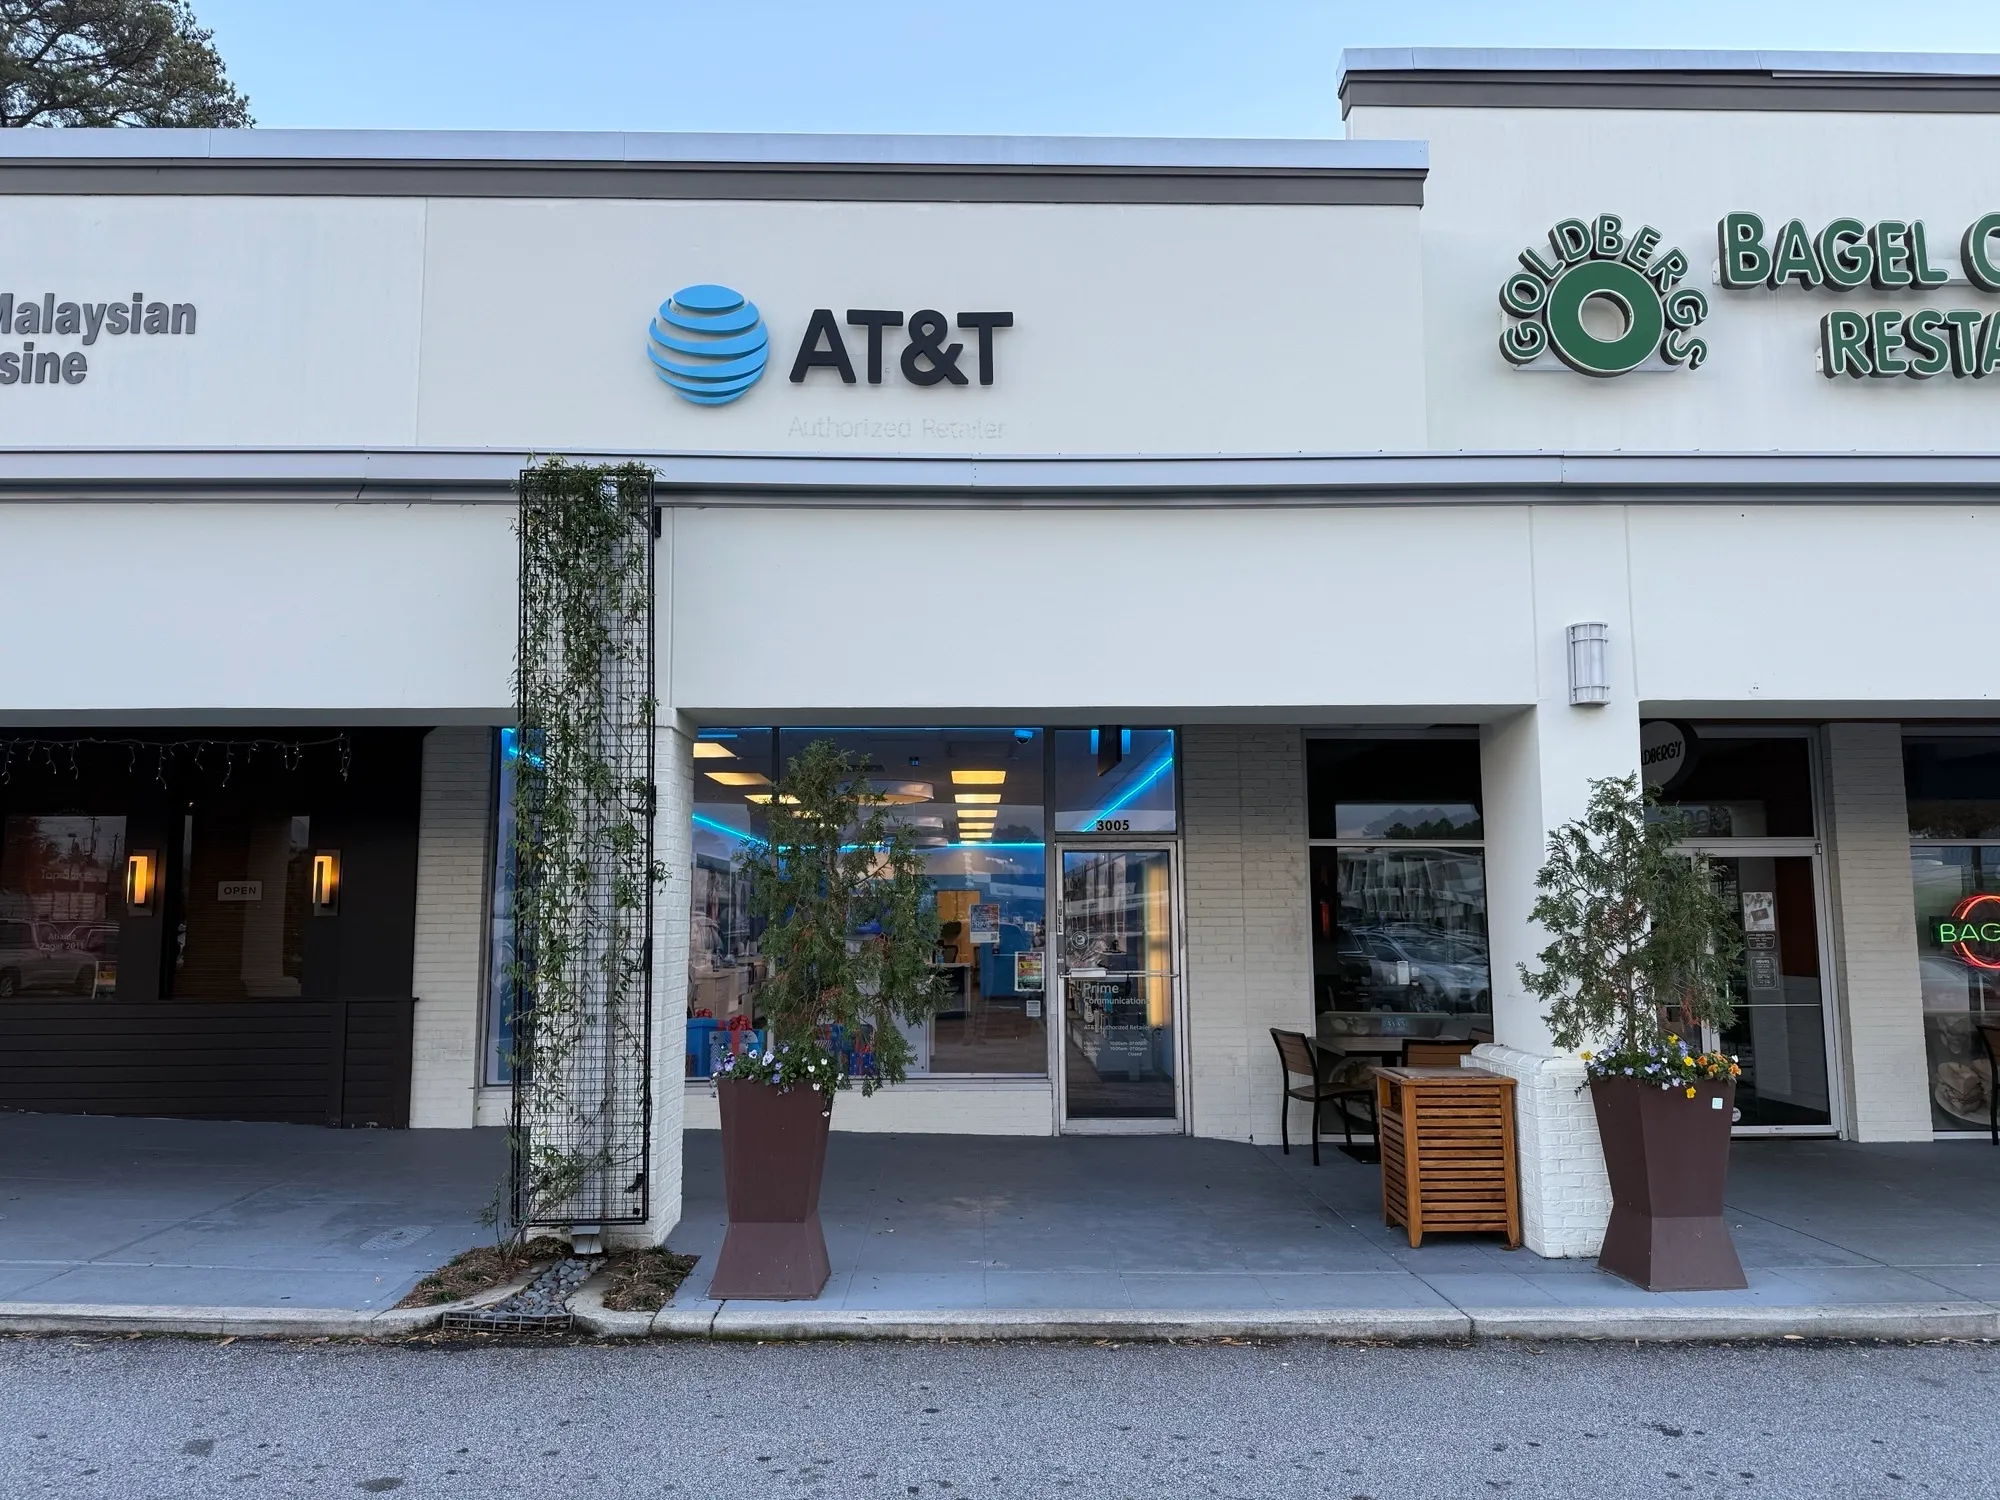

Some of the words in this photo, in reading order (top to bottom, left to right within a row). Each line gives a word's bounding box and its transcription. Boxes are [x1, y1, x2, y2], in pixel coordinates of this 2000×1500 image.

[1717, 211, 1949, 290] BAGEL
[1498, 213, 1709, 371] GOLDBERGS
[789, 308, 1014, 387] AT&T
[788, 415, 911, 439] Authorized
[1096, 819, 1130, 832] 3005
[41, 869, 59, 883] Top
[223, 886, 257, 896] OPEN
[1083, 983, 1119, 994] Prime
[1083, 997, 1151, 1005] Communications
